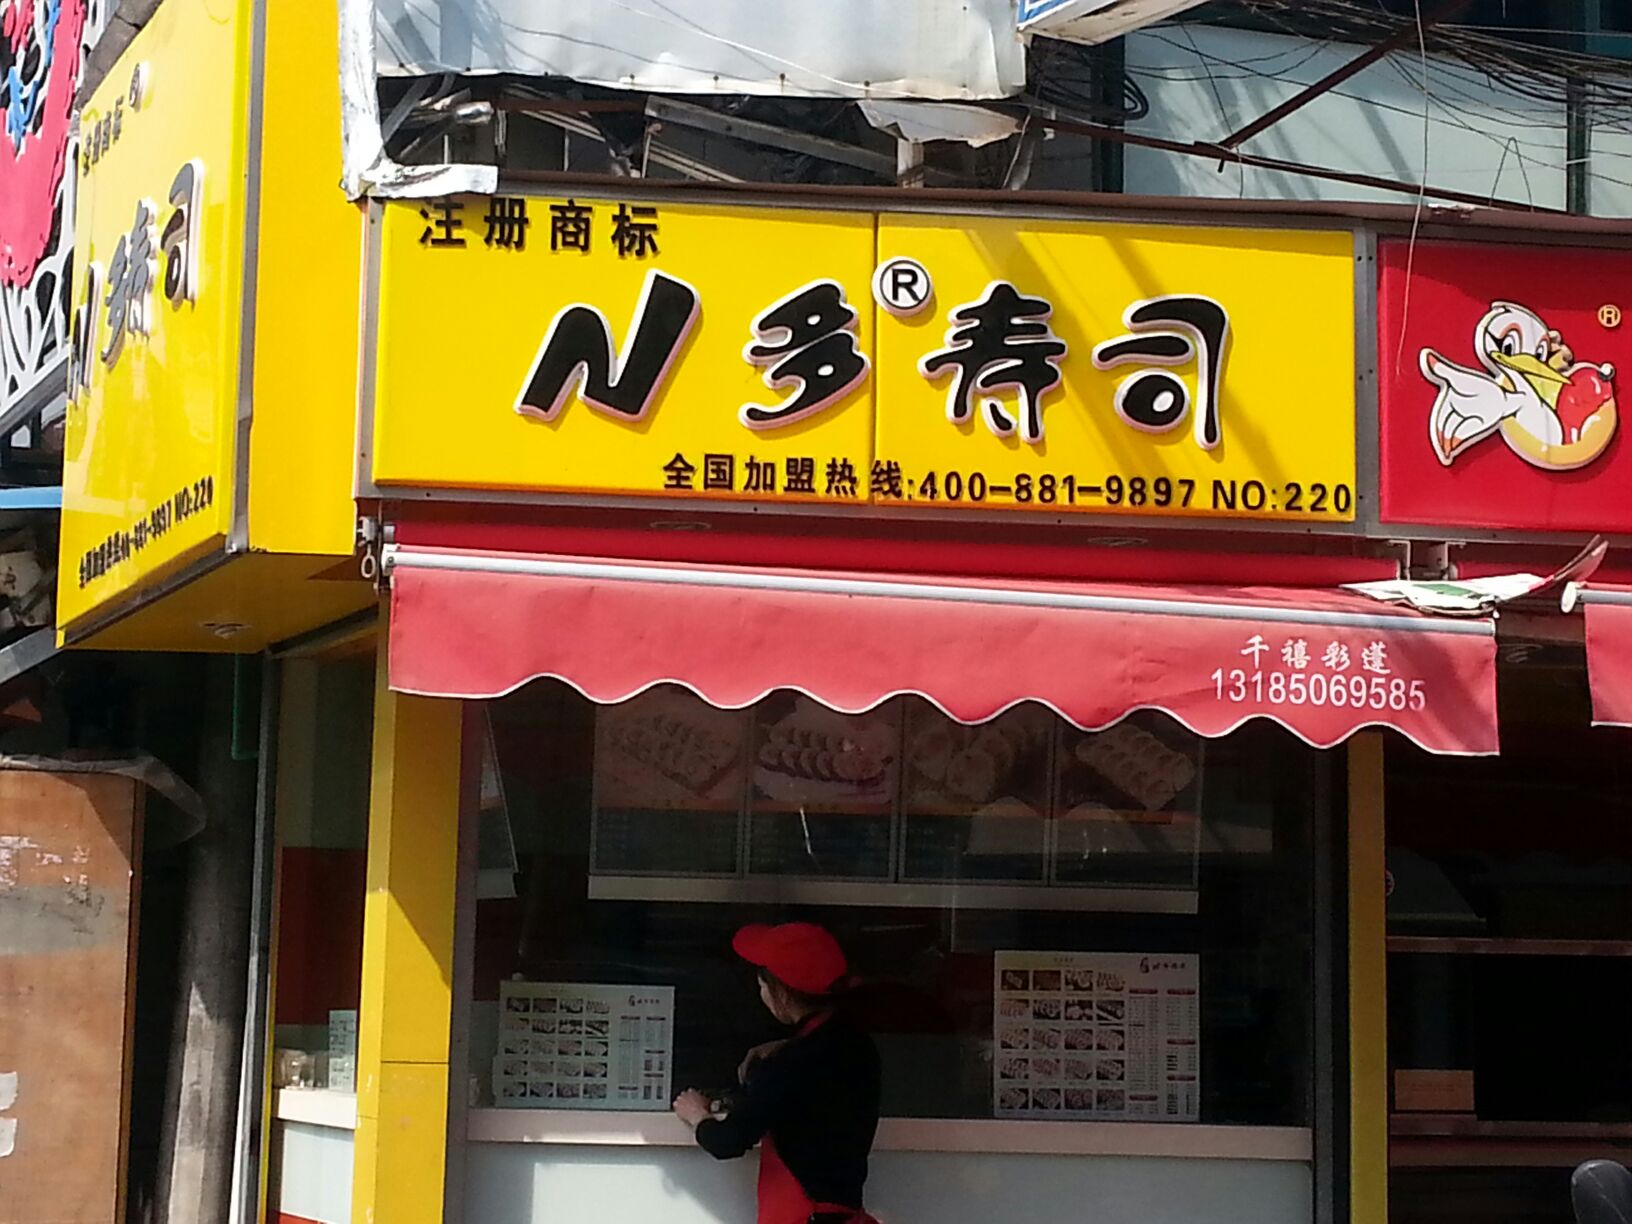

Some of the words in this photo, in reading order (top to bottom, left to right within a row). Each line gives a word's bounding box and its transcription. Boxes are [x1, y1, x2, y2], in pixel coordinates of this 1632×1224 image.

[419, 198, 660, 257] 注册商标
[1212, 480, 1352, 513] NO:220
[1210, 668, 1426, 712] 13185069585
